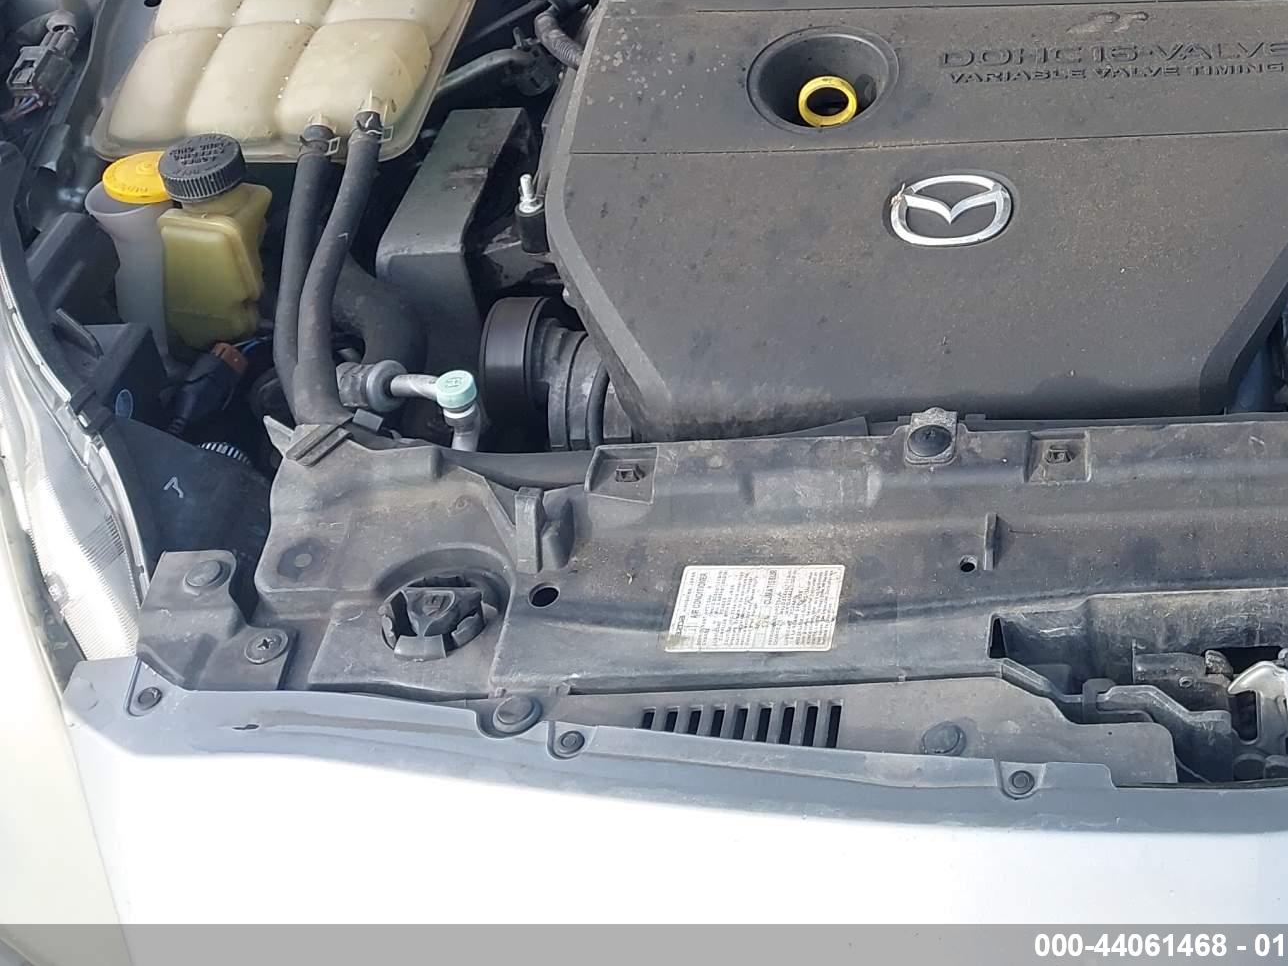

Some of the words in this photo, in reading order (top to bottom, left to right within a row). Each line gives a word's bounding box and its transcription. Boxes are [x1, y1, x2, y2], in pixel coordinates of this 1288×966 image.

[942, 45, 1083, 67] DOHC
[950, 68, 1087, 84] VARIABLE
[1095, 65, 1181, 79] VALVE
[1191, 62, 1285, 76] TIMING
